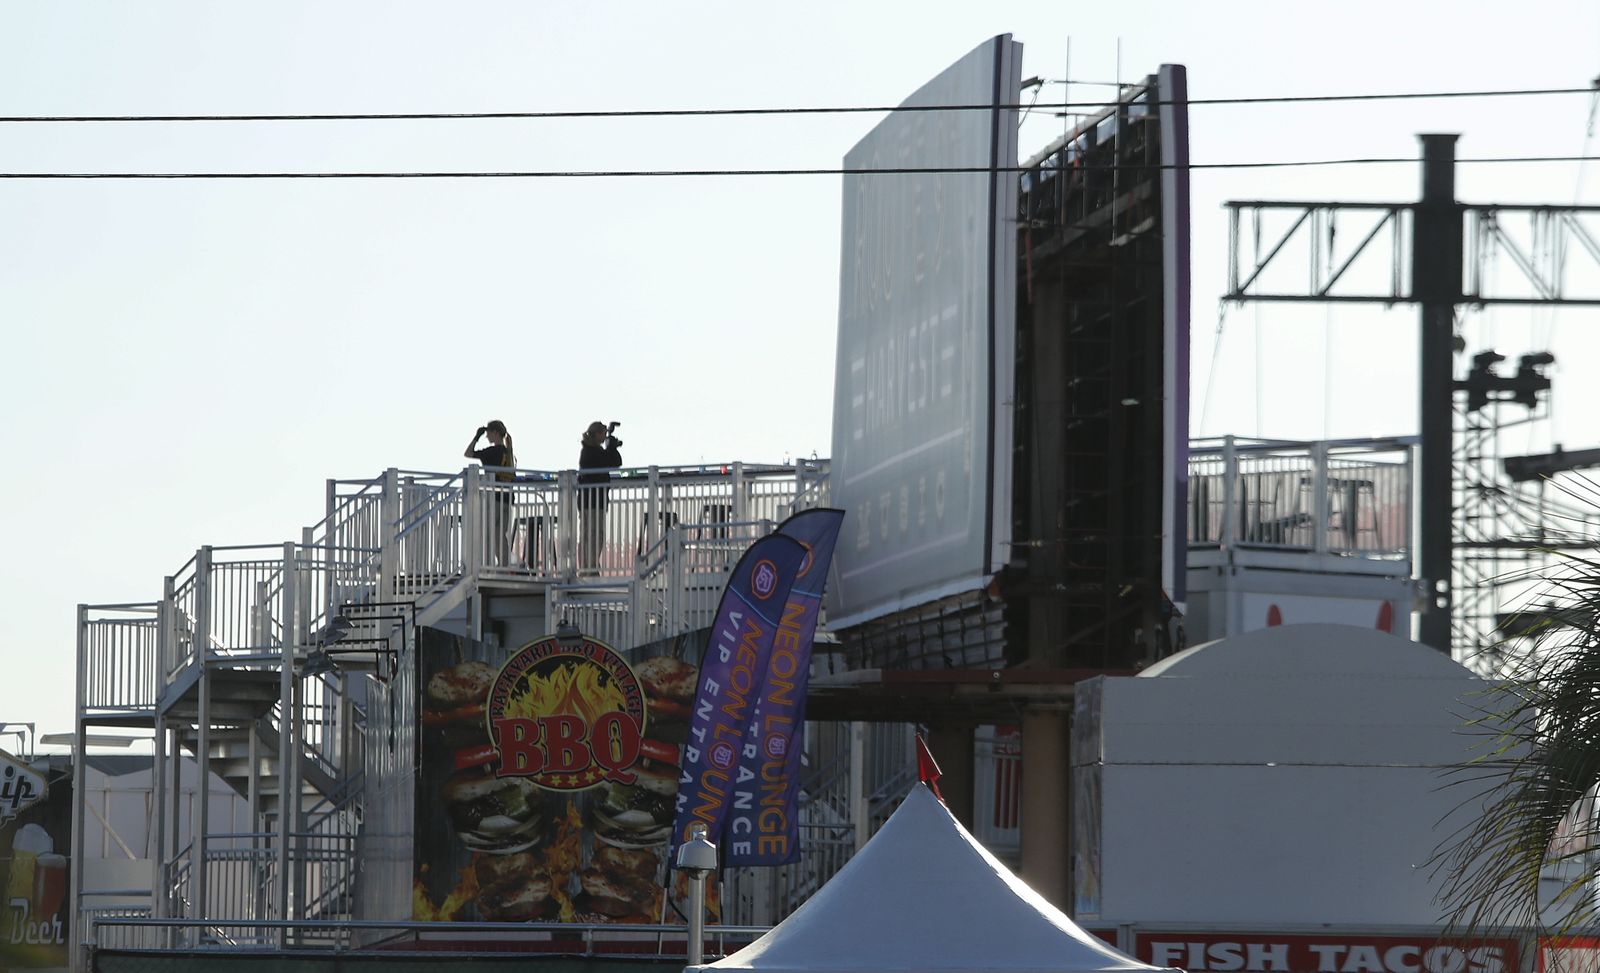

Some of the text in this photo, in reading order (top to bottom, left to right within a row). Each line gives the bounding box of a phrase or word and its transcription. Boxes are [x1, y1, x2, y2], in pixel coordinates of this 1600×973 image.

[718, 611, 742, 663] VIP
[493, 642, 553, 716] BACKYARD
[493, 711, 638, 785] BBQ
[683, 618, 763, 842] NEON LOUNG
[757, 602, 805, 856] NEON LOUNGE
[0, 765, 36, 809] ip
[8, 897, 64, 944] Beer
[1151, 941, 1505, 973] FISH TACOS
